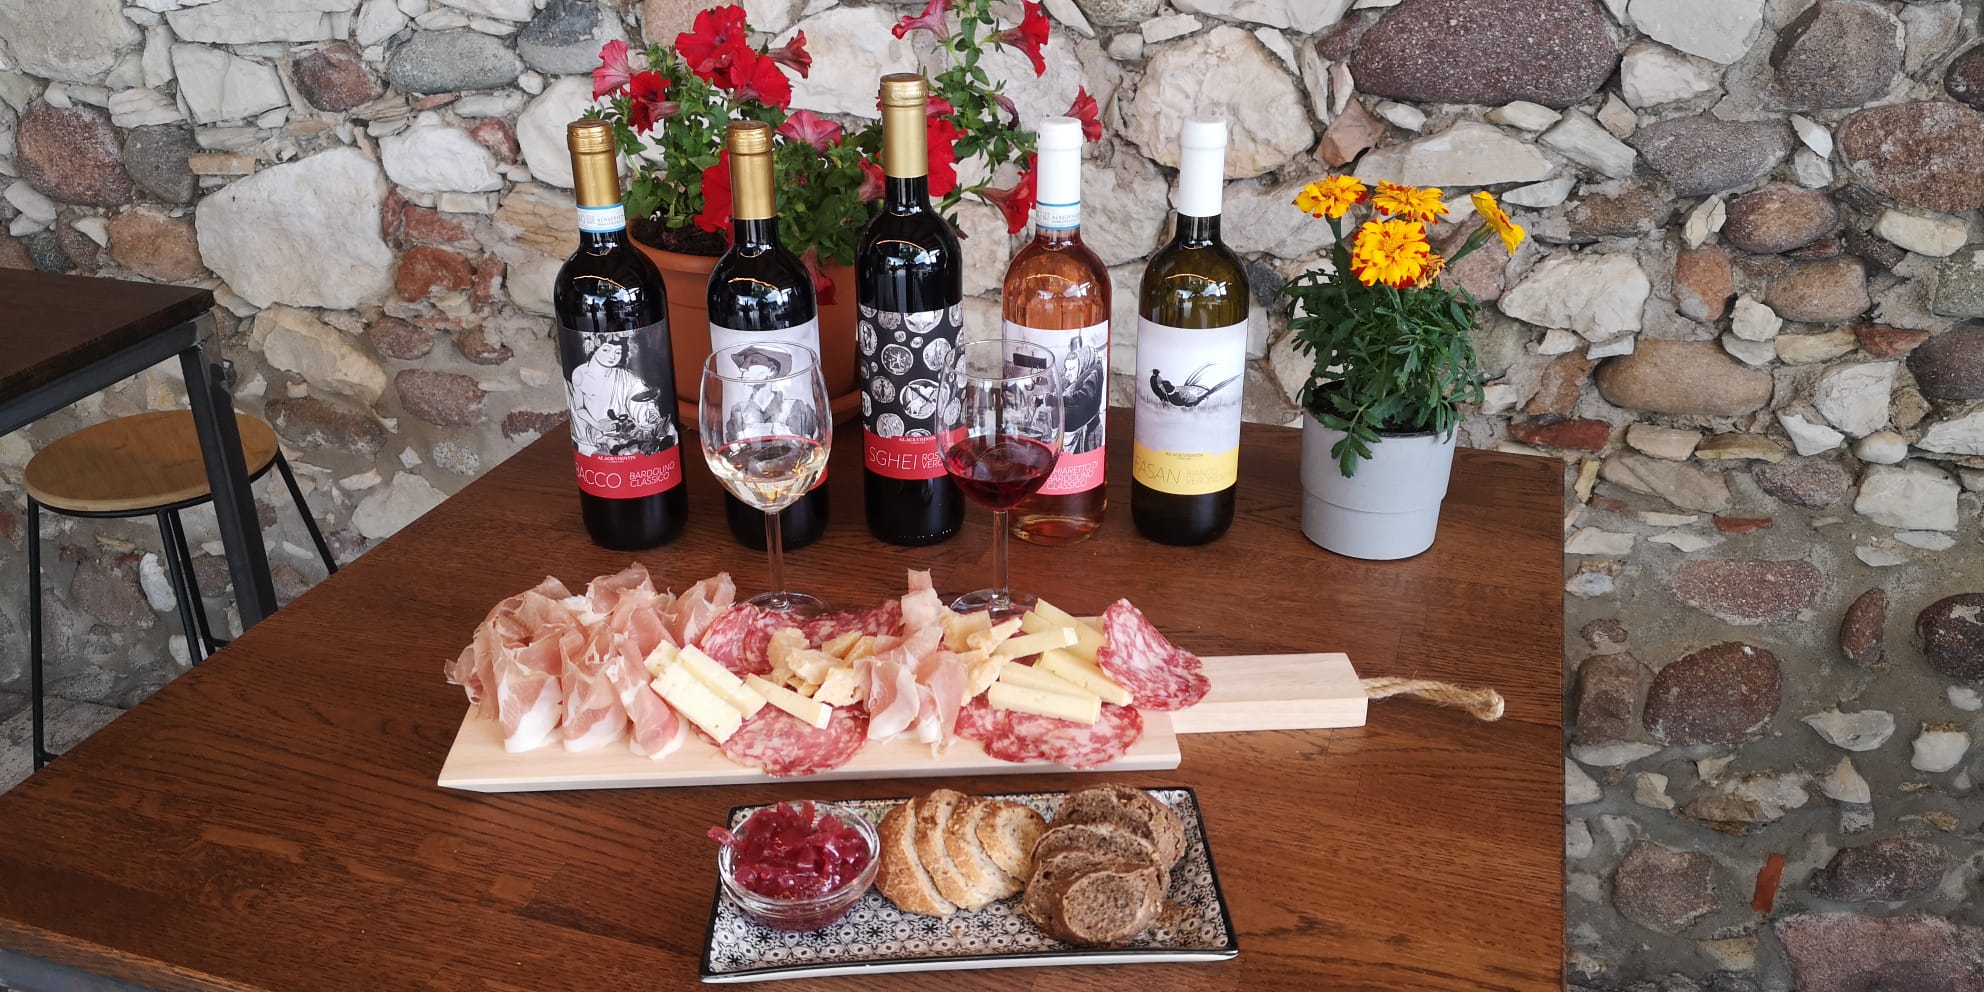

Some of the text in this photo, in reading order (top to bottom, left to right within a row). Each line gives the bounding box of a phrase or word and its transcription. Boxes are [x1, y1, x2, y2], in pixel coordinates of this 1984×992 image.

[869, 446, 918, 470] SGHEI
[629, 460, 675, 480] BARDOLINO
[1053, 463, 1091, 475] HIARETTO
[1135, 455, 1181, 485] FASAN
[630, 471, 670, 488] CLASSICO
[1046, 479, 1087, 490] CLASSICO
